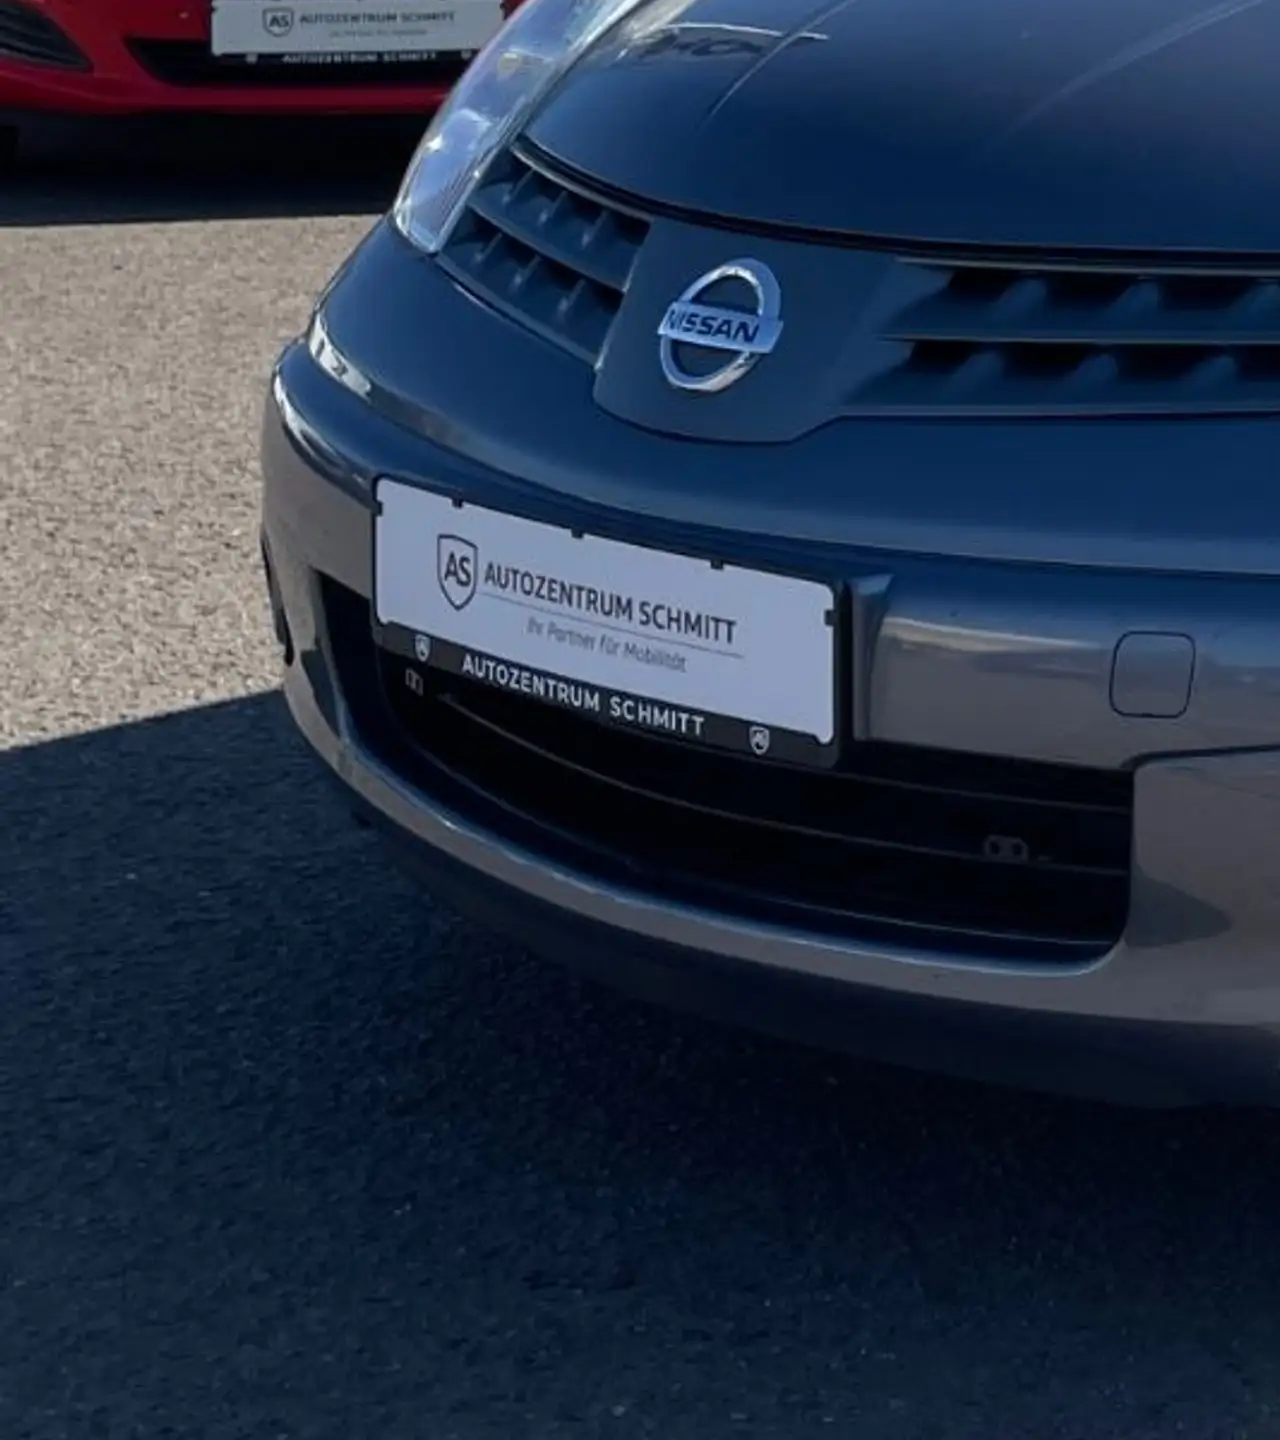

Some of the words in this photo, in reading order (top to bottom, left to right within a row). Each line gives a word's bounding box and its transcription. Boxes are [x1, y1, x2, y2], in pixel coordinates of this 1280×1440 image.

[668, 308, 760, 343] NISSAN
[443, 551, 472, 588] AS
[484, 561, 634, 623] AUTOZENTRUM
[638, 600, 737, 645] SCHMITT
[547, 621, 597, 653] Partner
[600, 632, 620, 654] für
[461, 654, 600, 712] AUTOZENTRUM
[609, 696, 705, 736] SCHMITT
